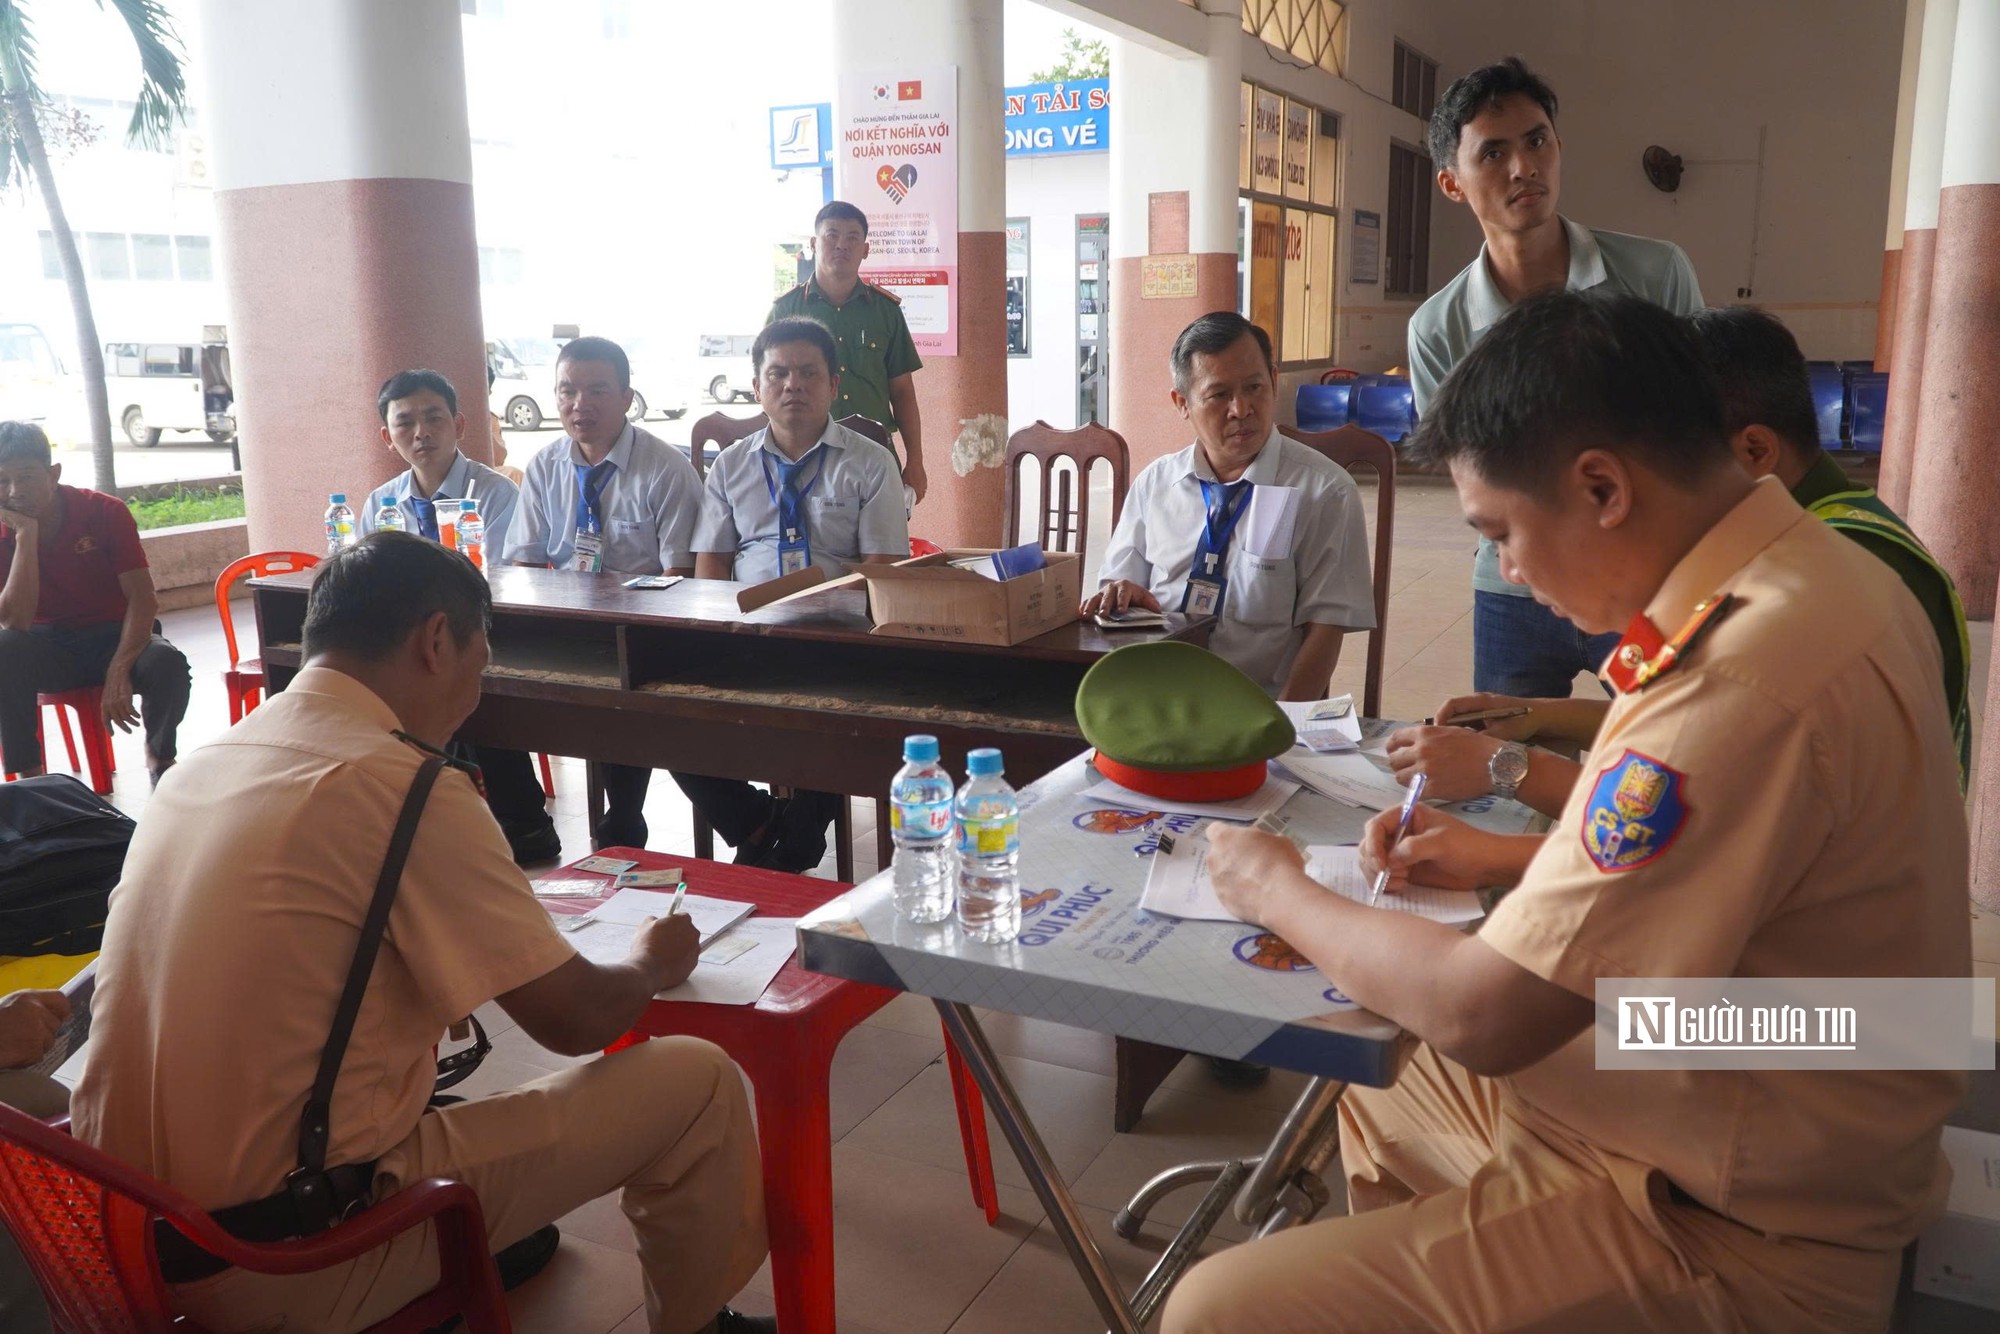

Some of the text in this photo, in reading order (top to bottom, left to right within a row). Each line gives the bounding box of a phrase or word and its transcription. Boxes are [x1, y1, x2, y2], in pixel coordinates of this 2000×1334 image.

[1032, 84, 1081, 113] TẢI
[1088, 88, 1110, 110] S
[845, 121, 949, 142] NƠI KẾT NGHĨA VỚI
[1061, 117, 1097, 146] VÉ
[852, 142, 941, 160] QUẬN YONGSAN
[867, 230, 896, 238] WELCOME
[898, 238, 916, 246] TOWN
[919, 246, 940, 254] KOREA
[1018, 919, 1072, 946] QUI
